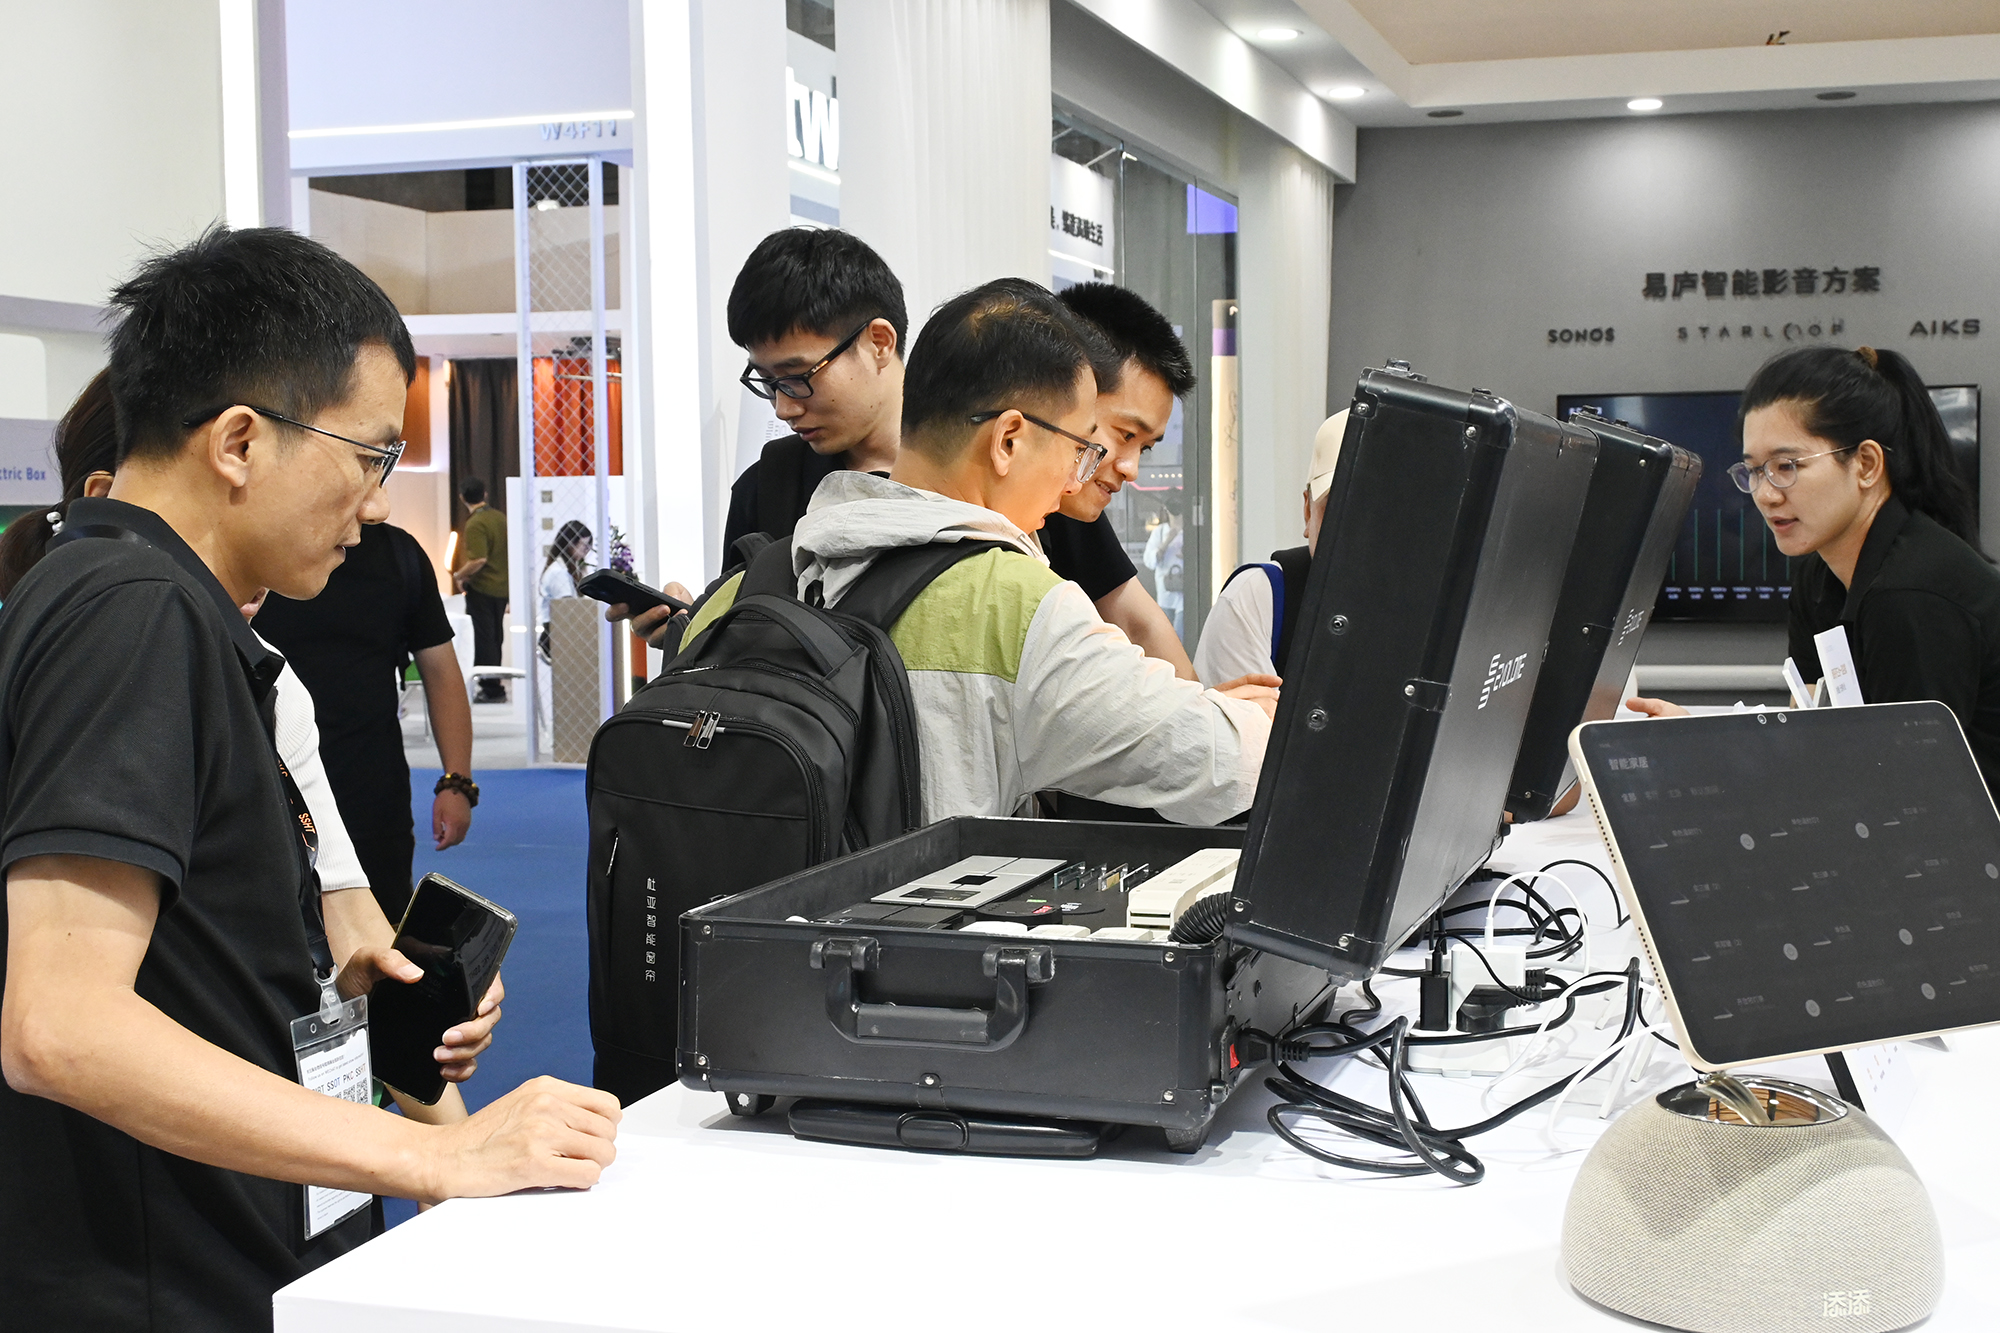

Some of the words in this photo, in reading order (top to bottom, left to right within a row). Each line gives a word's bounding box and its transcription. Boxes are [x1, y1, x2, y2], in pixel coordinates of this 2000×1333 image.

[540, 119, 618, 141] W4F11
[1642, 266, 1880, 299] 易庐智能影音方案
[1548, 327, 1615, 344] SONOS
[1910, 319, 1981, 337] AIKS
[0, 467, 22, 480] tric
[26, 467, 46, 480] Box
[298, 812, 316, 834] SSHT
[1823, 1289, 1870, 1317] 添添
